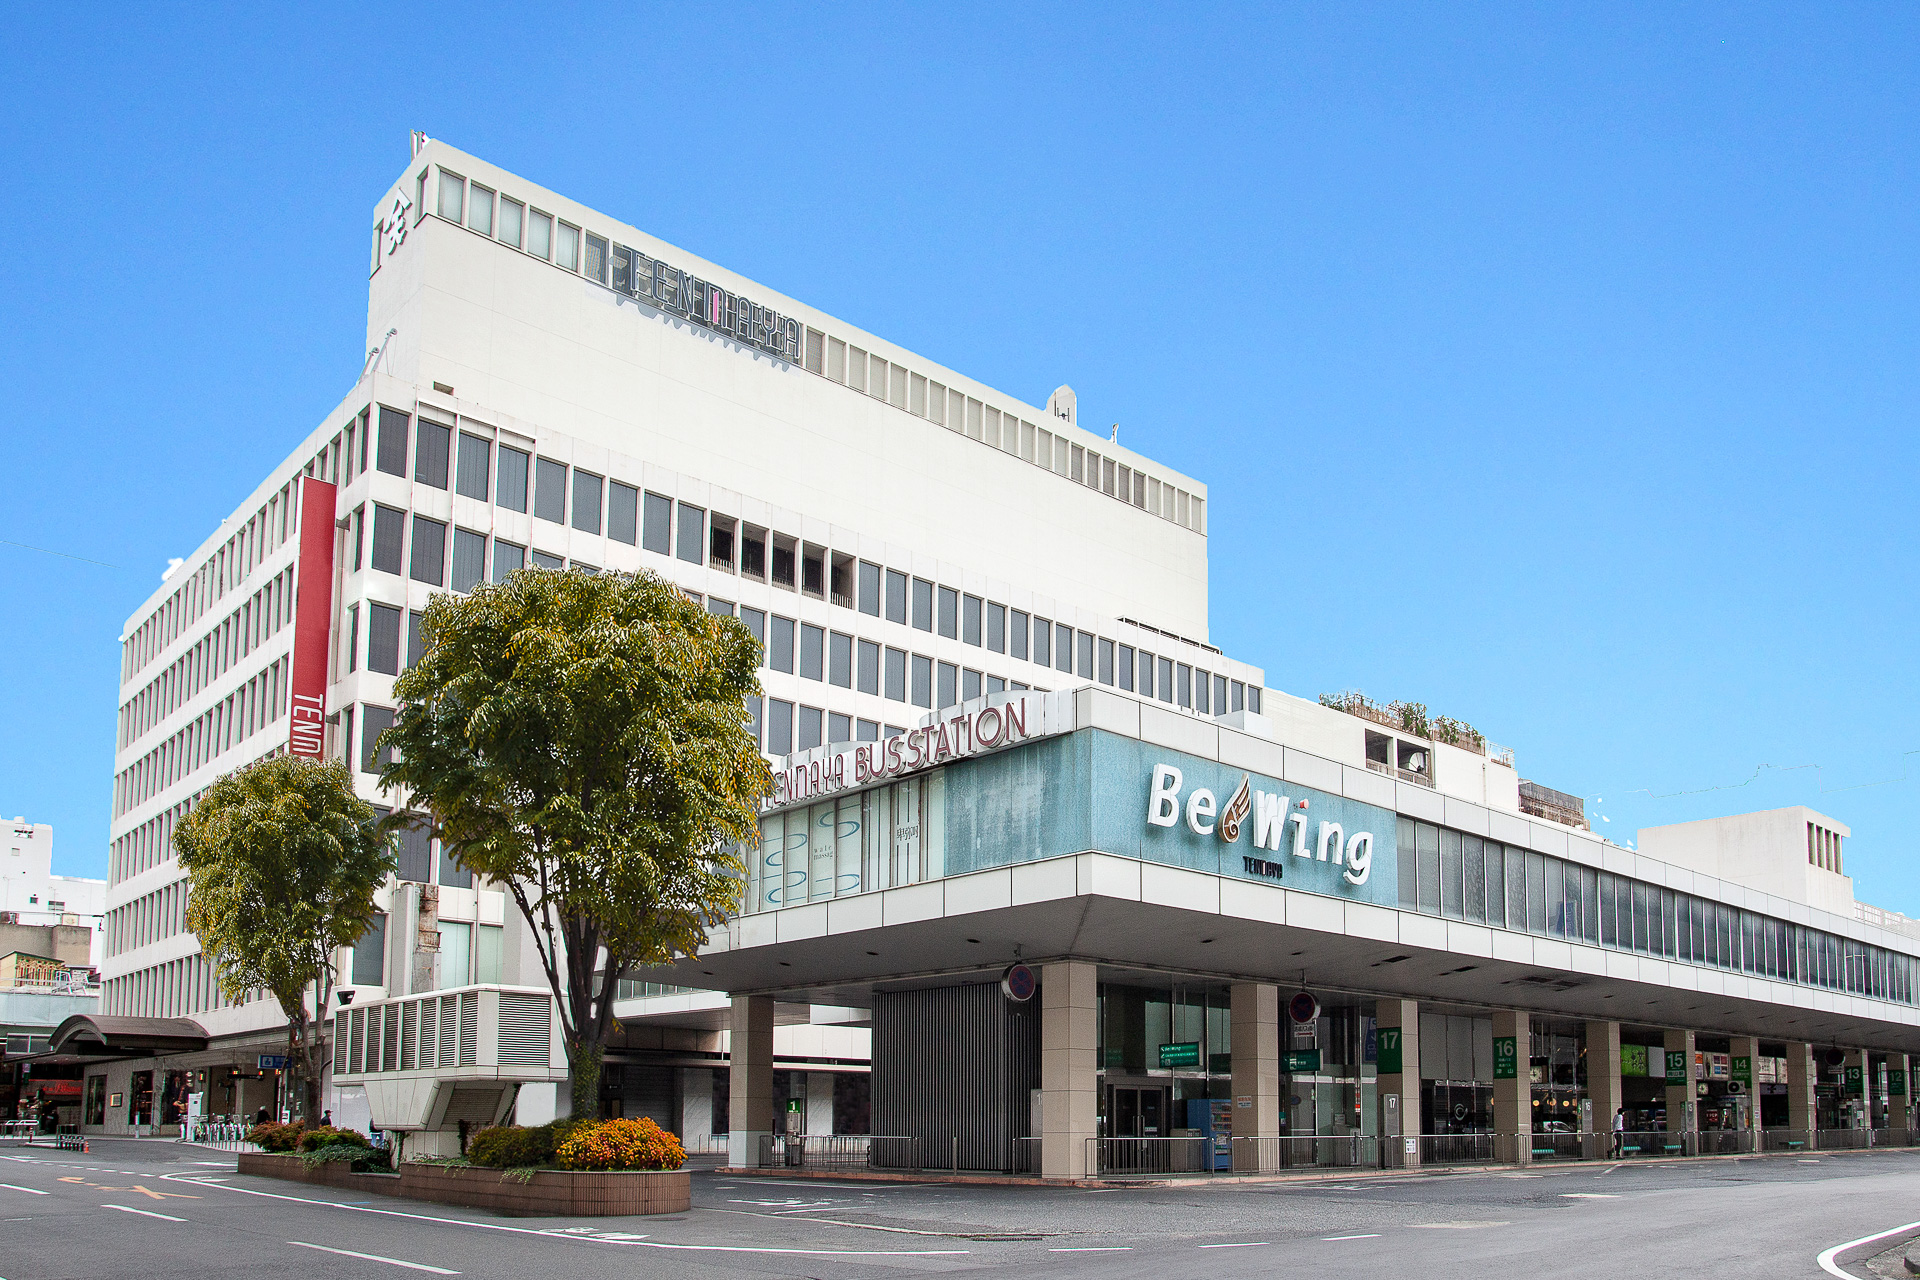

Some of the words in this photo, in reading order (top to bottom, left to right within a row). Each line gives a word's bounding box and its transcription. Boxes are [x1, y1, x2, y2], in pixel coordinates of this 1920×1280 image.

[622, 244, 801, 359] TENMAYA
[293, 694, 324, 757] TENM
[1147, 763, 1217, 835] Be
[1253, 789, 1374, 886] Wing
[1242, 855, 1283, 879] TENMAYA
[1381, 1032, 1399, 1050] 17
[1496, 1040, 1514, 1057] 16
[1667, 1053, 1684, 1068] 15
[1735, 1059, 1747, 1069] 14
[1846, 1068, 1860, 1079] 13
[1890, 1071, 1902, 1082] 12
[790, 1100, 796, 1110] 1
[1388, 1097, 1396, 1109] 17
